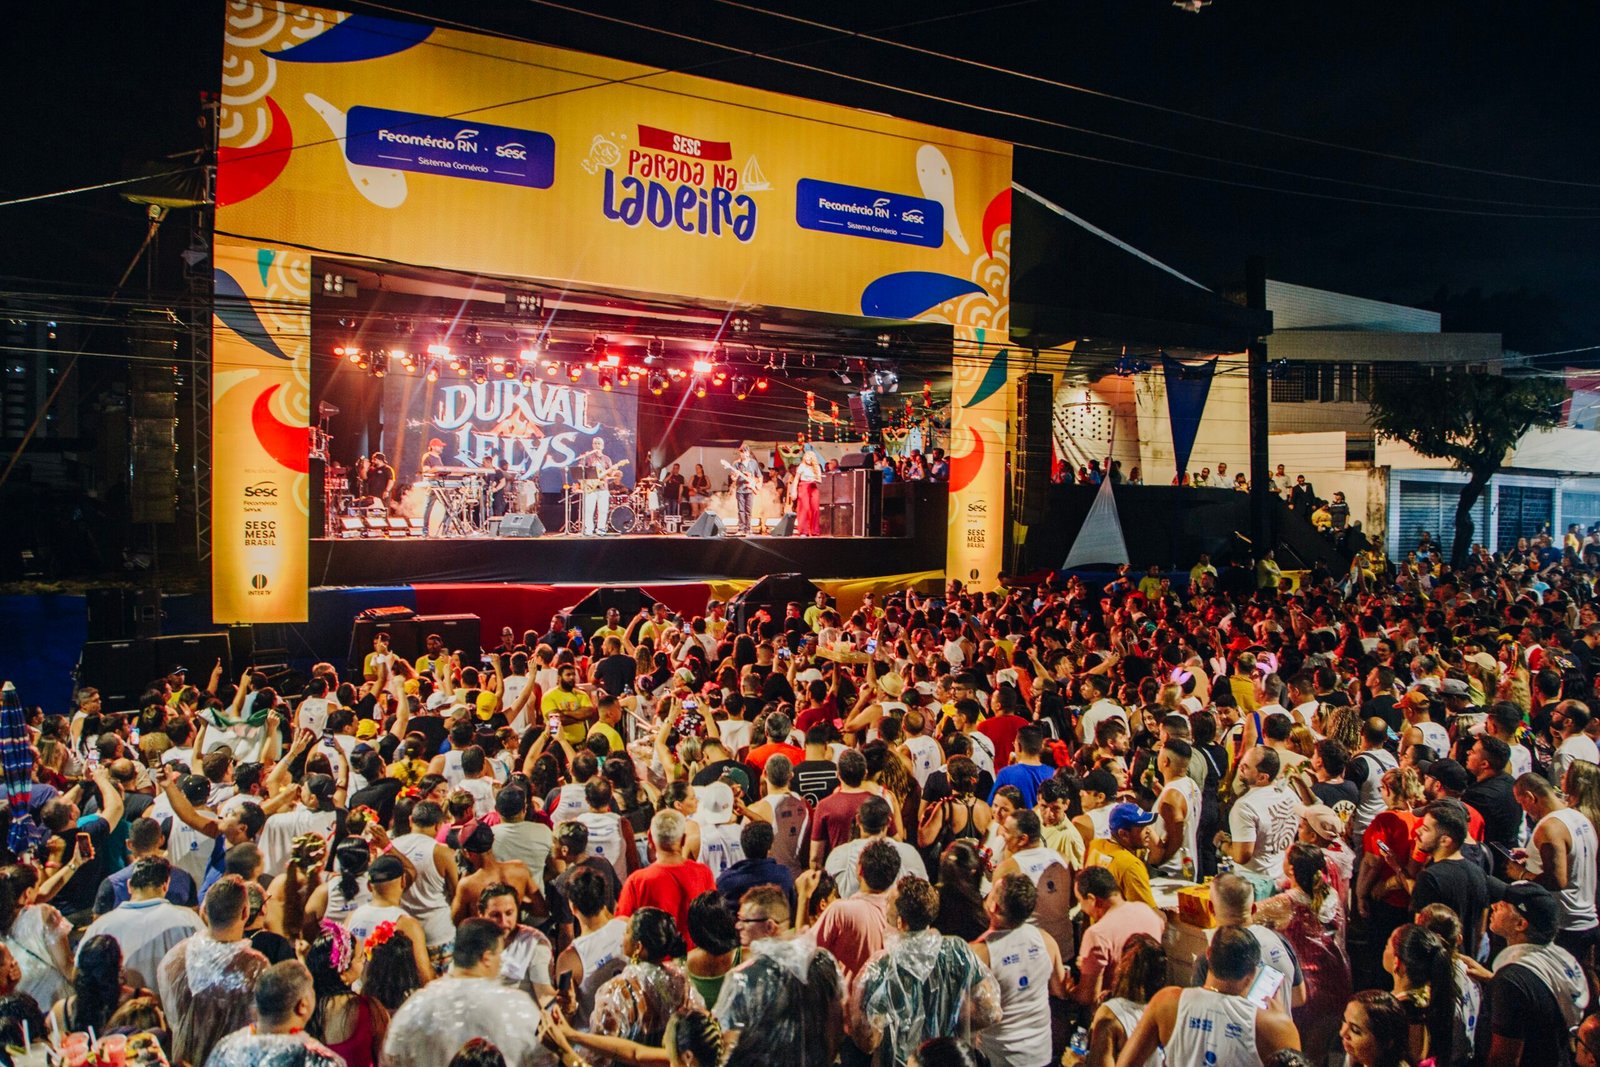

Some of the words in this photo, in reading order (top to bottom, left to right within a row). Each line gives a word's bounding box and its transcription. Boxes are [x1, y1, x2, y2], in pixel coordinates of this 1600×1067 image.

[378, 129, 454, 150] Fecomércio
[457, 140, 477, 153] RN
[672, 135, 701, 156] SESC
[495, 145, 527, 160] Sesc
[418, 157, 451, 168] Sistema
[453, 161, 489, 173] Comércio
[818, 198, 873, 216] Fecomércio
[875, 206, 890, 219] RN
[902, 211, 924, 225] Sesc
[847, 221, 871, 232] Sistema
[872, 225, 898, 236] Comércio
[433, 378, 601, 435] DURVAL
[244, 485, 278, 497] Sesc
[968, 502, 987, 513] Sesc
[245, 520, 276, 530] SESC
[245, 530, 276, 539] MESA
